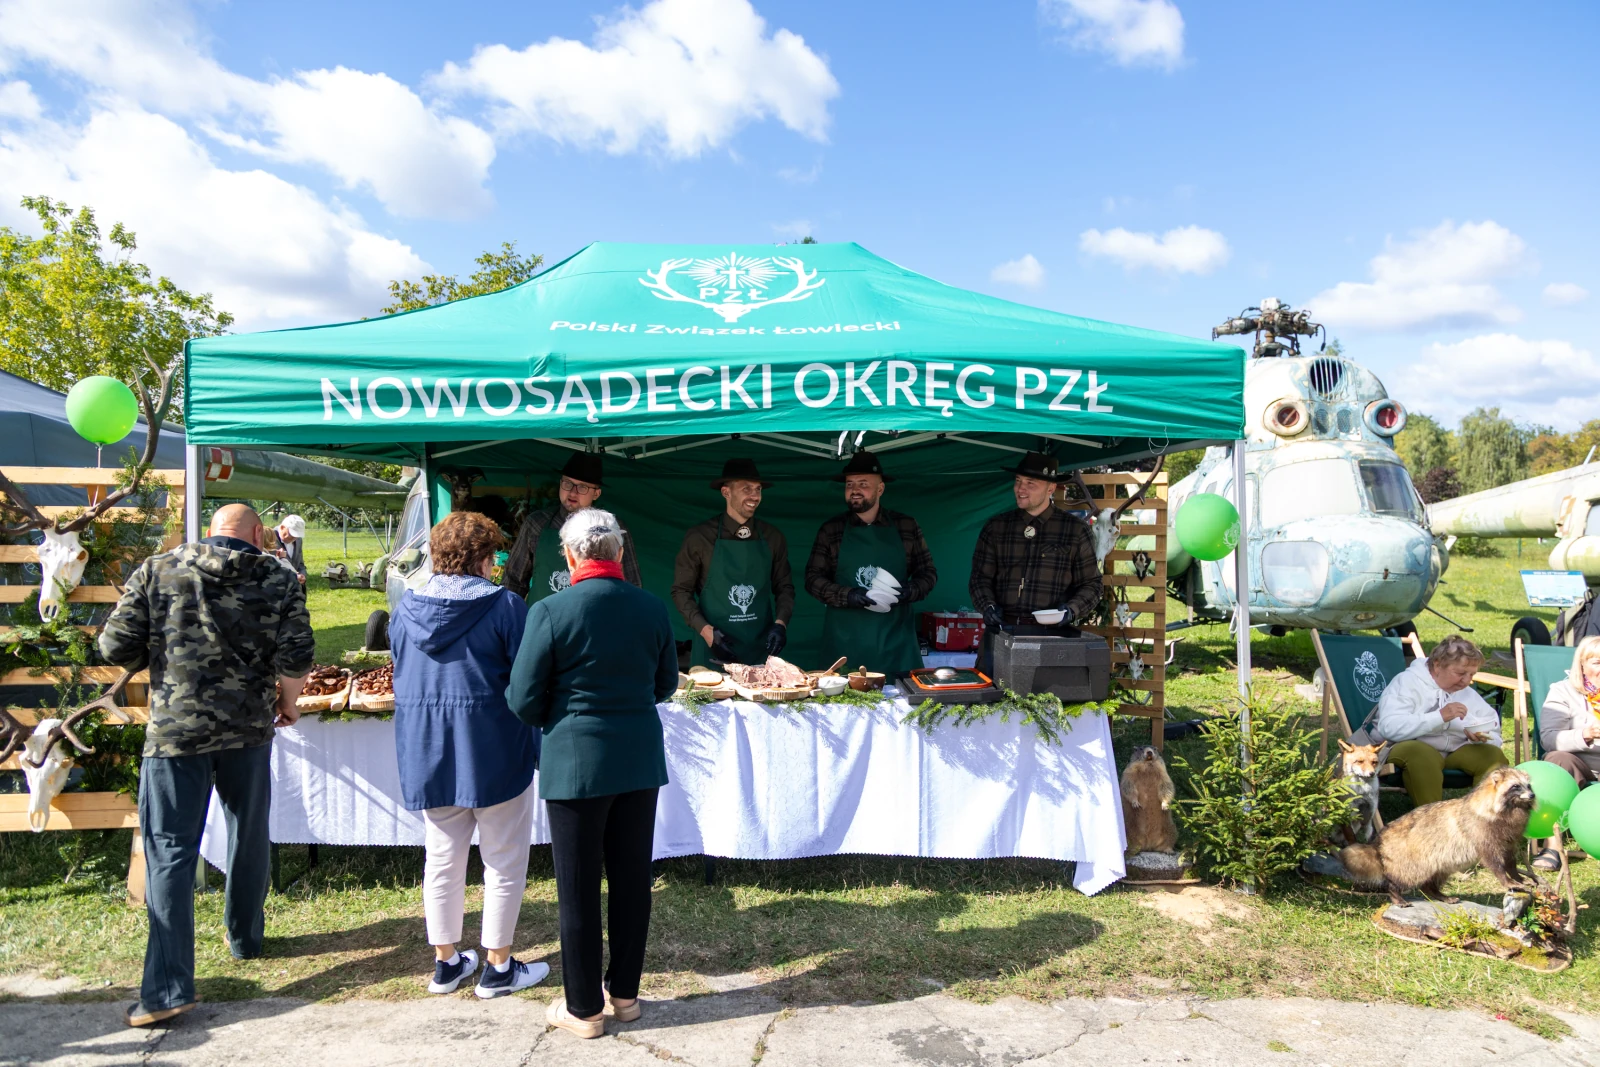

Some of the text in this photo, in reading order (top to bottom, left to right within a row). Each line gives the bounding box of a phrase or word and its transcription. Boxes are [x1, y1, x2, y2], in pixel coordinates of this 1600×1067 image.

[700, 287, 769, 303] PZŁ
[549, 320, 901, 336] Polski Związek Łowiecki
[320, 360, 1115, 423] NOWOSĄDECKI OKRĘG PZŁ
[1365, 676, 1376, 684] 60
